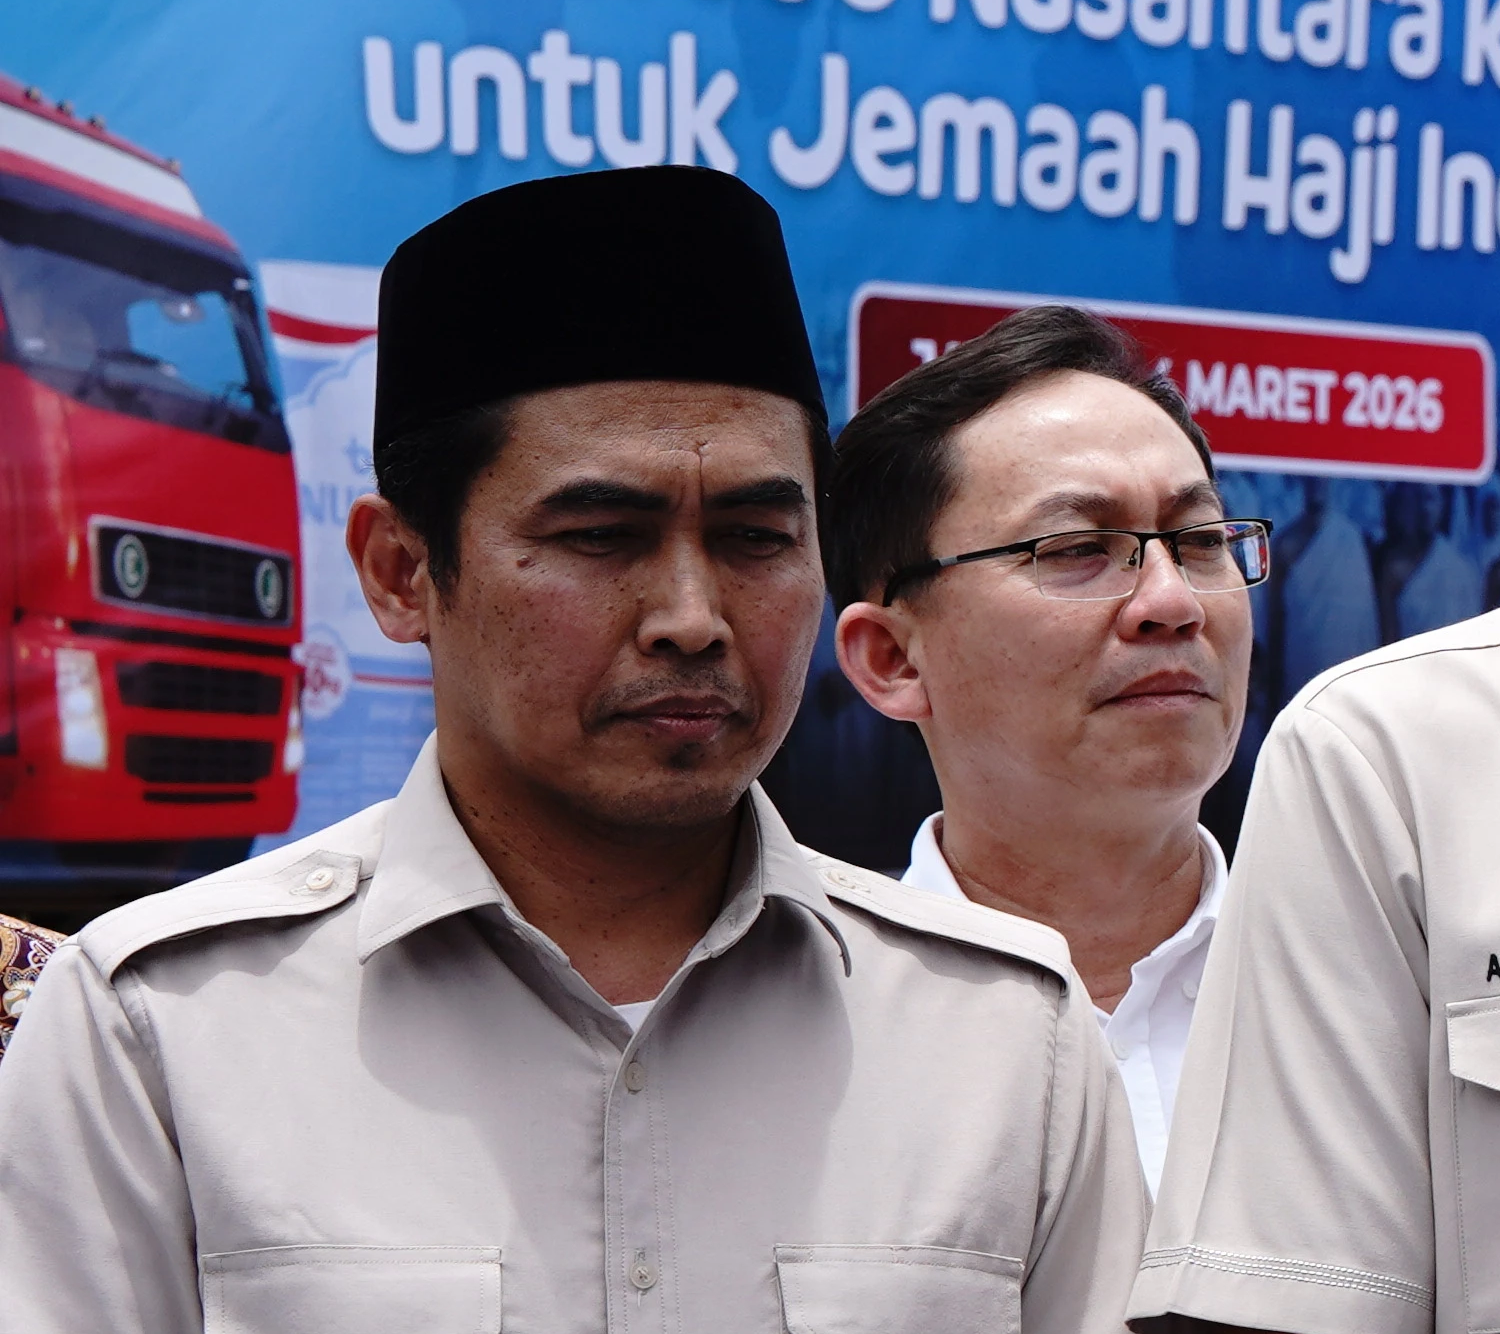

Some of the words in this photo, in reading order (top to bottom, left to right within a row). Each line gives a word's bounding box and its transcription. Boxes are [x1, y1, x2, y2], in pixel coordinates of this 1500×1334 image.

[362, 29, 740, 176] untuk
[767, 51, 1199, 225] Jemaah
[1222, 97, 1398, 285] Haji
[1185, 358, 1338, 425] MARET
[1342, 370, 1445, 434] 2026
